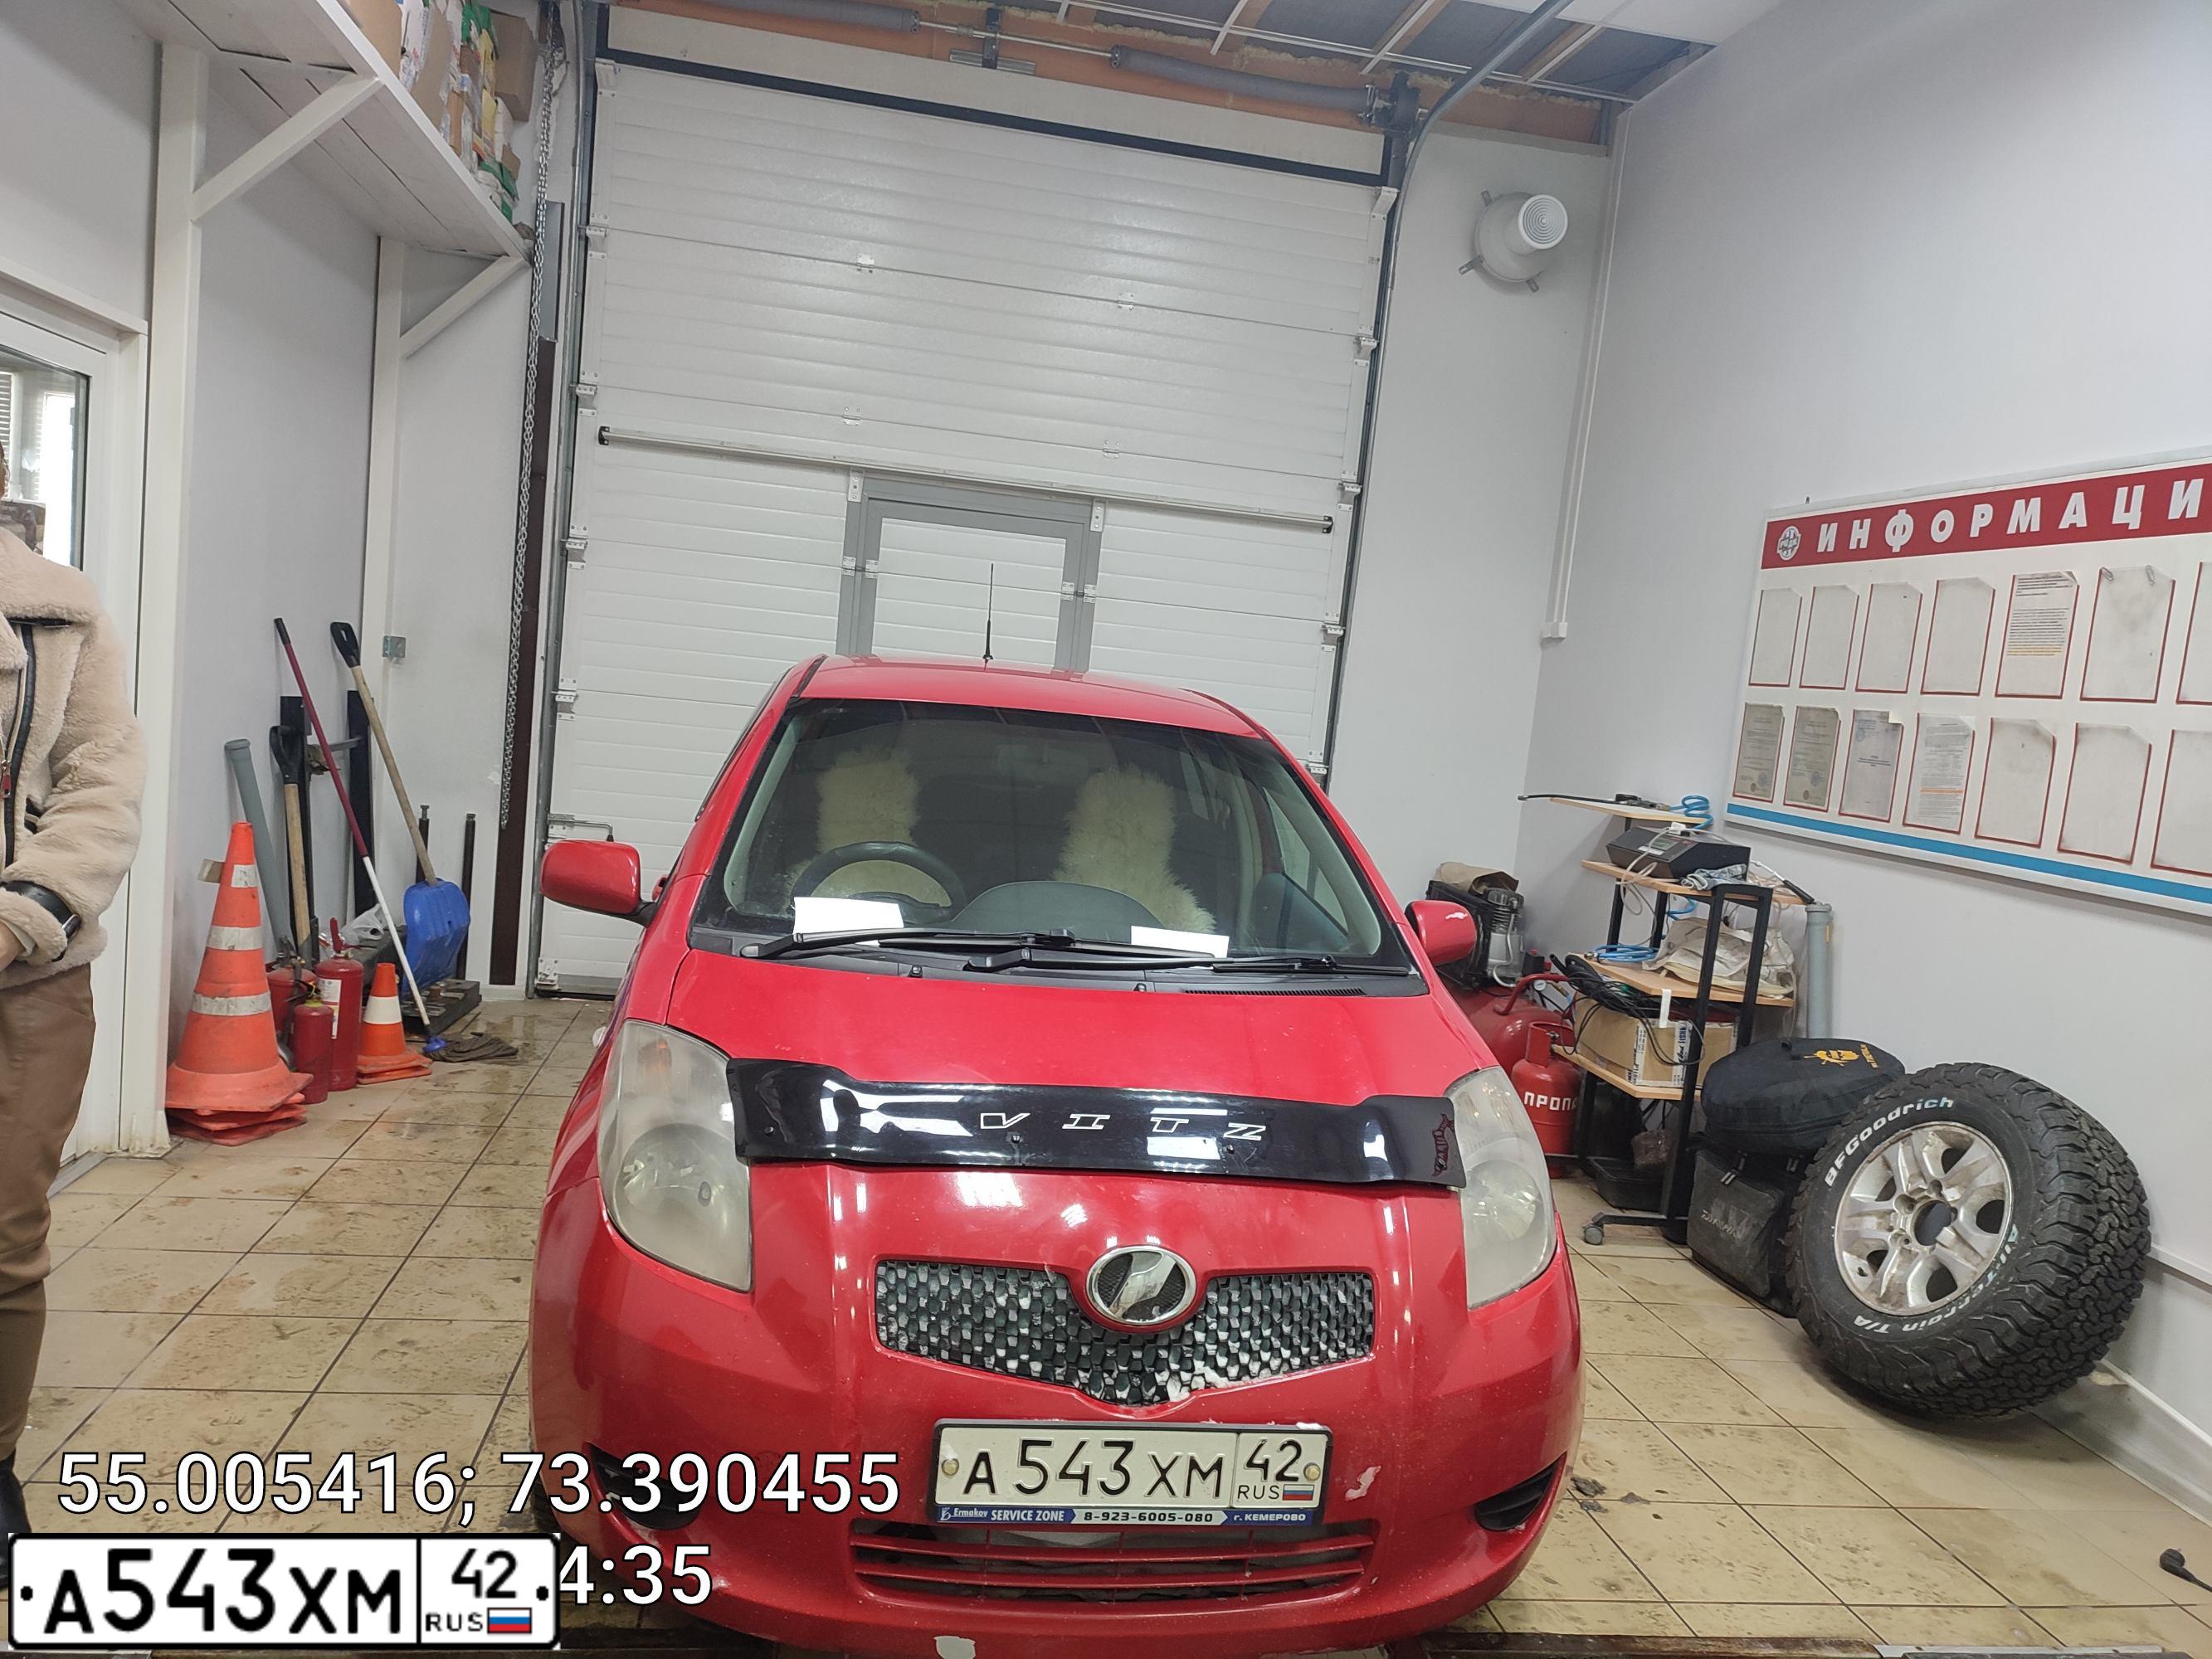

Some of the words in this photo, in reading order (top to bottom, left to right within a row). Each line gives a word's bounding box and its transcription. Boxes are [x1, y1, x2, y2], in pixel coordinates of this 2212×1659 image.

[1816, 478, 2205, 552] ИНФОРМАЦИ
[1825, 1097, 1955, 1187] BFGoodrich
[1245, 1438, 1303, 1483] 42
[1237, 1485, 1280, 1501] RUS
[953, 1507, 988, 1518] Ermakov
[991, 1510, 1033, 1521] SERVICE
[1035, 1511, 1065, 1522] ZONE
[1084, 1511, 1214, 1523] 8-923-6005-080
[1244, 1513, 1307, 1522] КЕМЕРОВО
